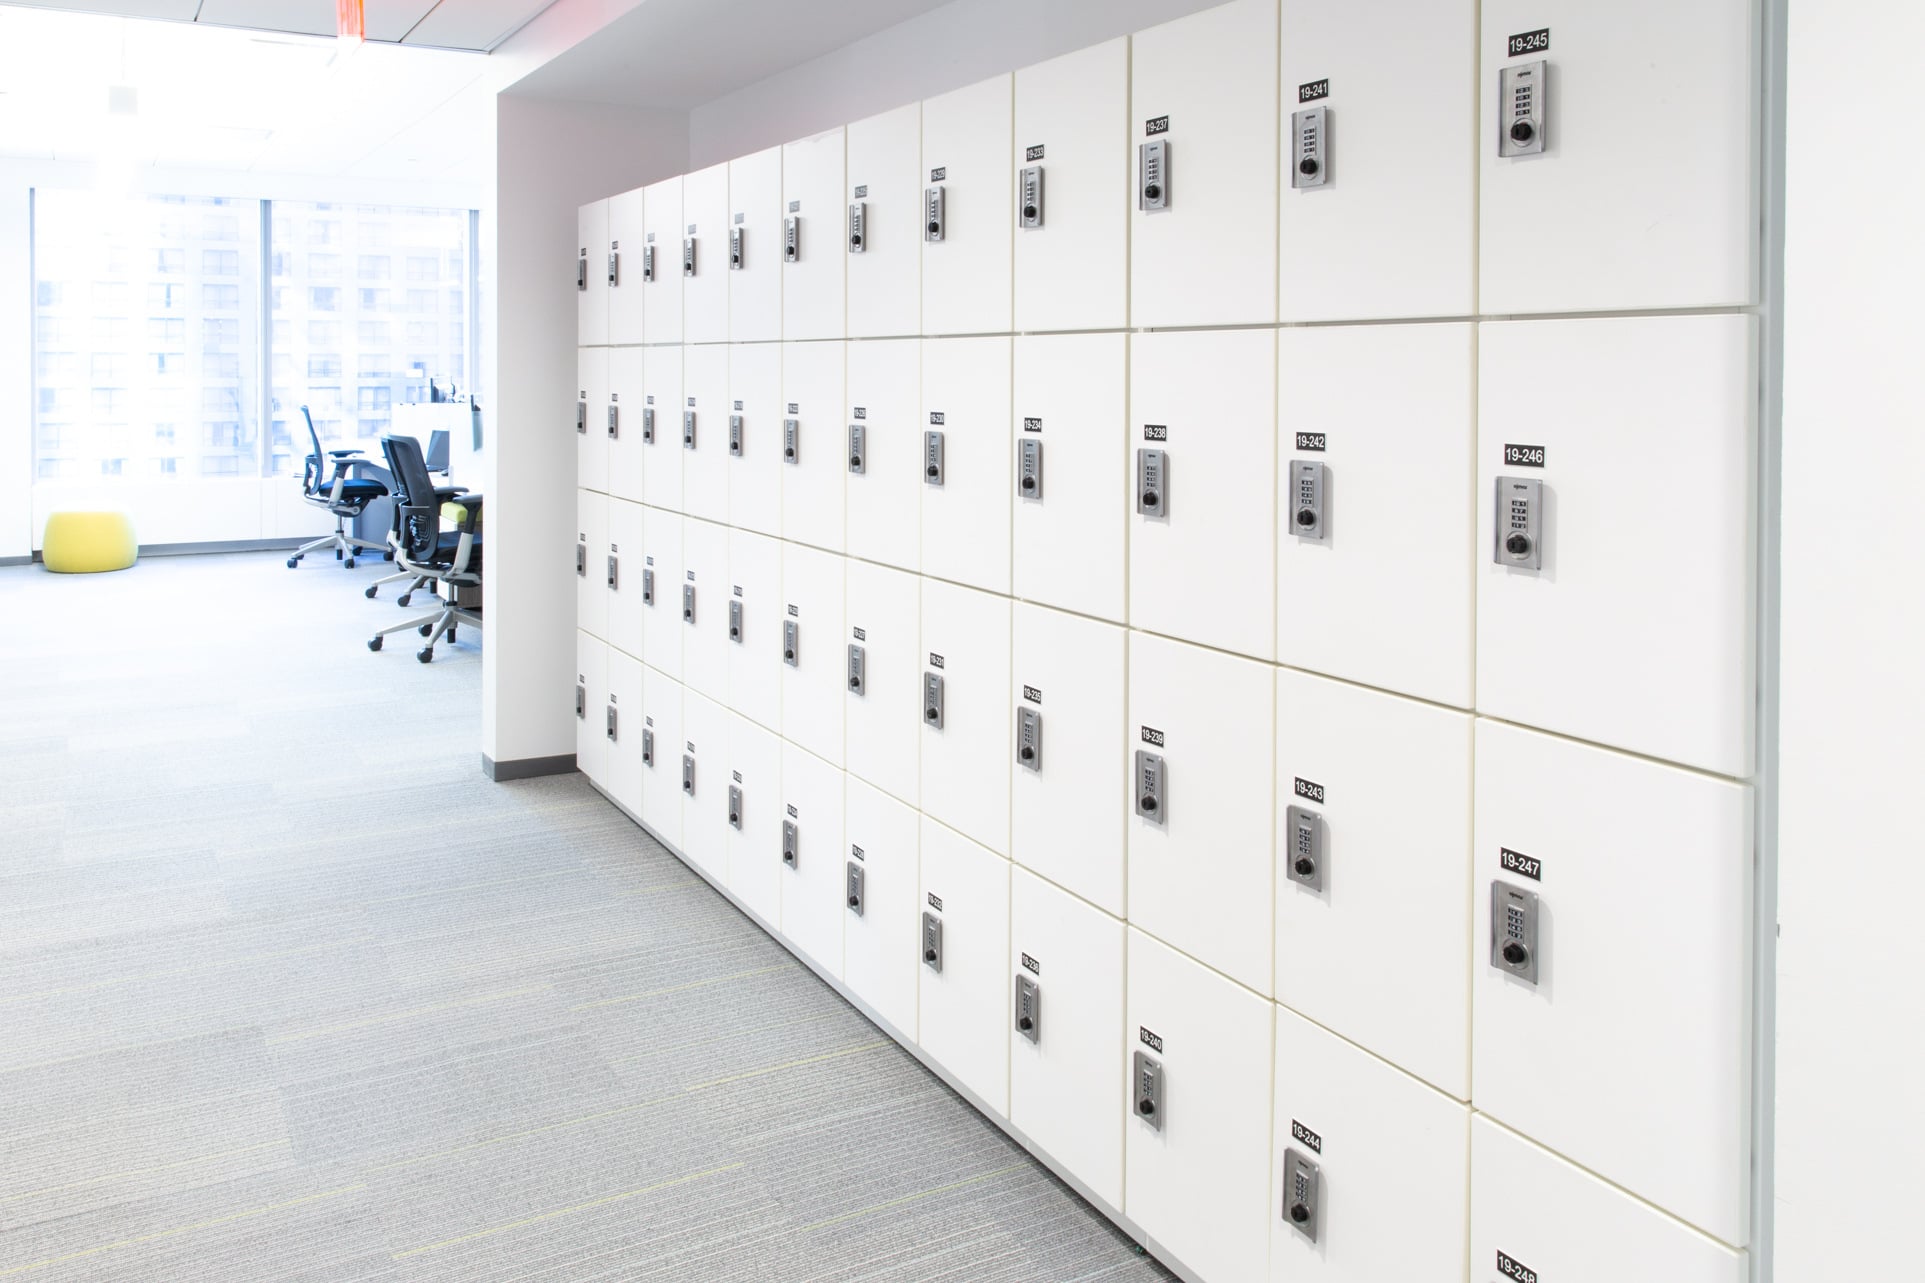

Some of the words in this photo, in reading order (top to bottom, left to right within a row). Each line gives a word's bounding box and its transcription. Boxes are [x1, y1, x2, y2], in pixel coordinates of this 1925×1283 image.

[1510, 33, 1547, 53] 19-245
[1301, 82, 1328, 99] 19-241
[1147, 118, 1168, 133] 19-237
[1027, 146, 1044, 160] 19-233
[1025, 419, 1041, 430] 19-234
[1145, 427, 1166, 439] 19-238
[1297, 435, 1324, 448] 19-242
[1506, 448, 1543, 463] 19-246
[1024, 687, 1041, 703] 19-235
[1142, 729, 1163, 745] 19-239
[1296, 780, 1323, 800] 19-243
[1502, 852, 1539, 876] 19-247
[1140, 1030, 1162, 1051] 19-240
[1293, 1124, 1320, 1150] 19-244
[1498, 1255, 1535, 1283] 19-248
